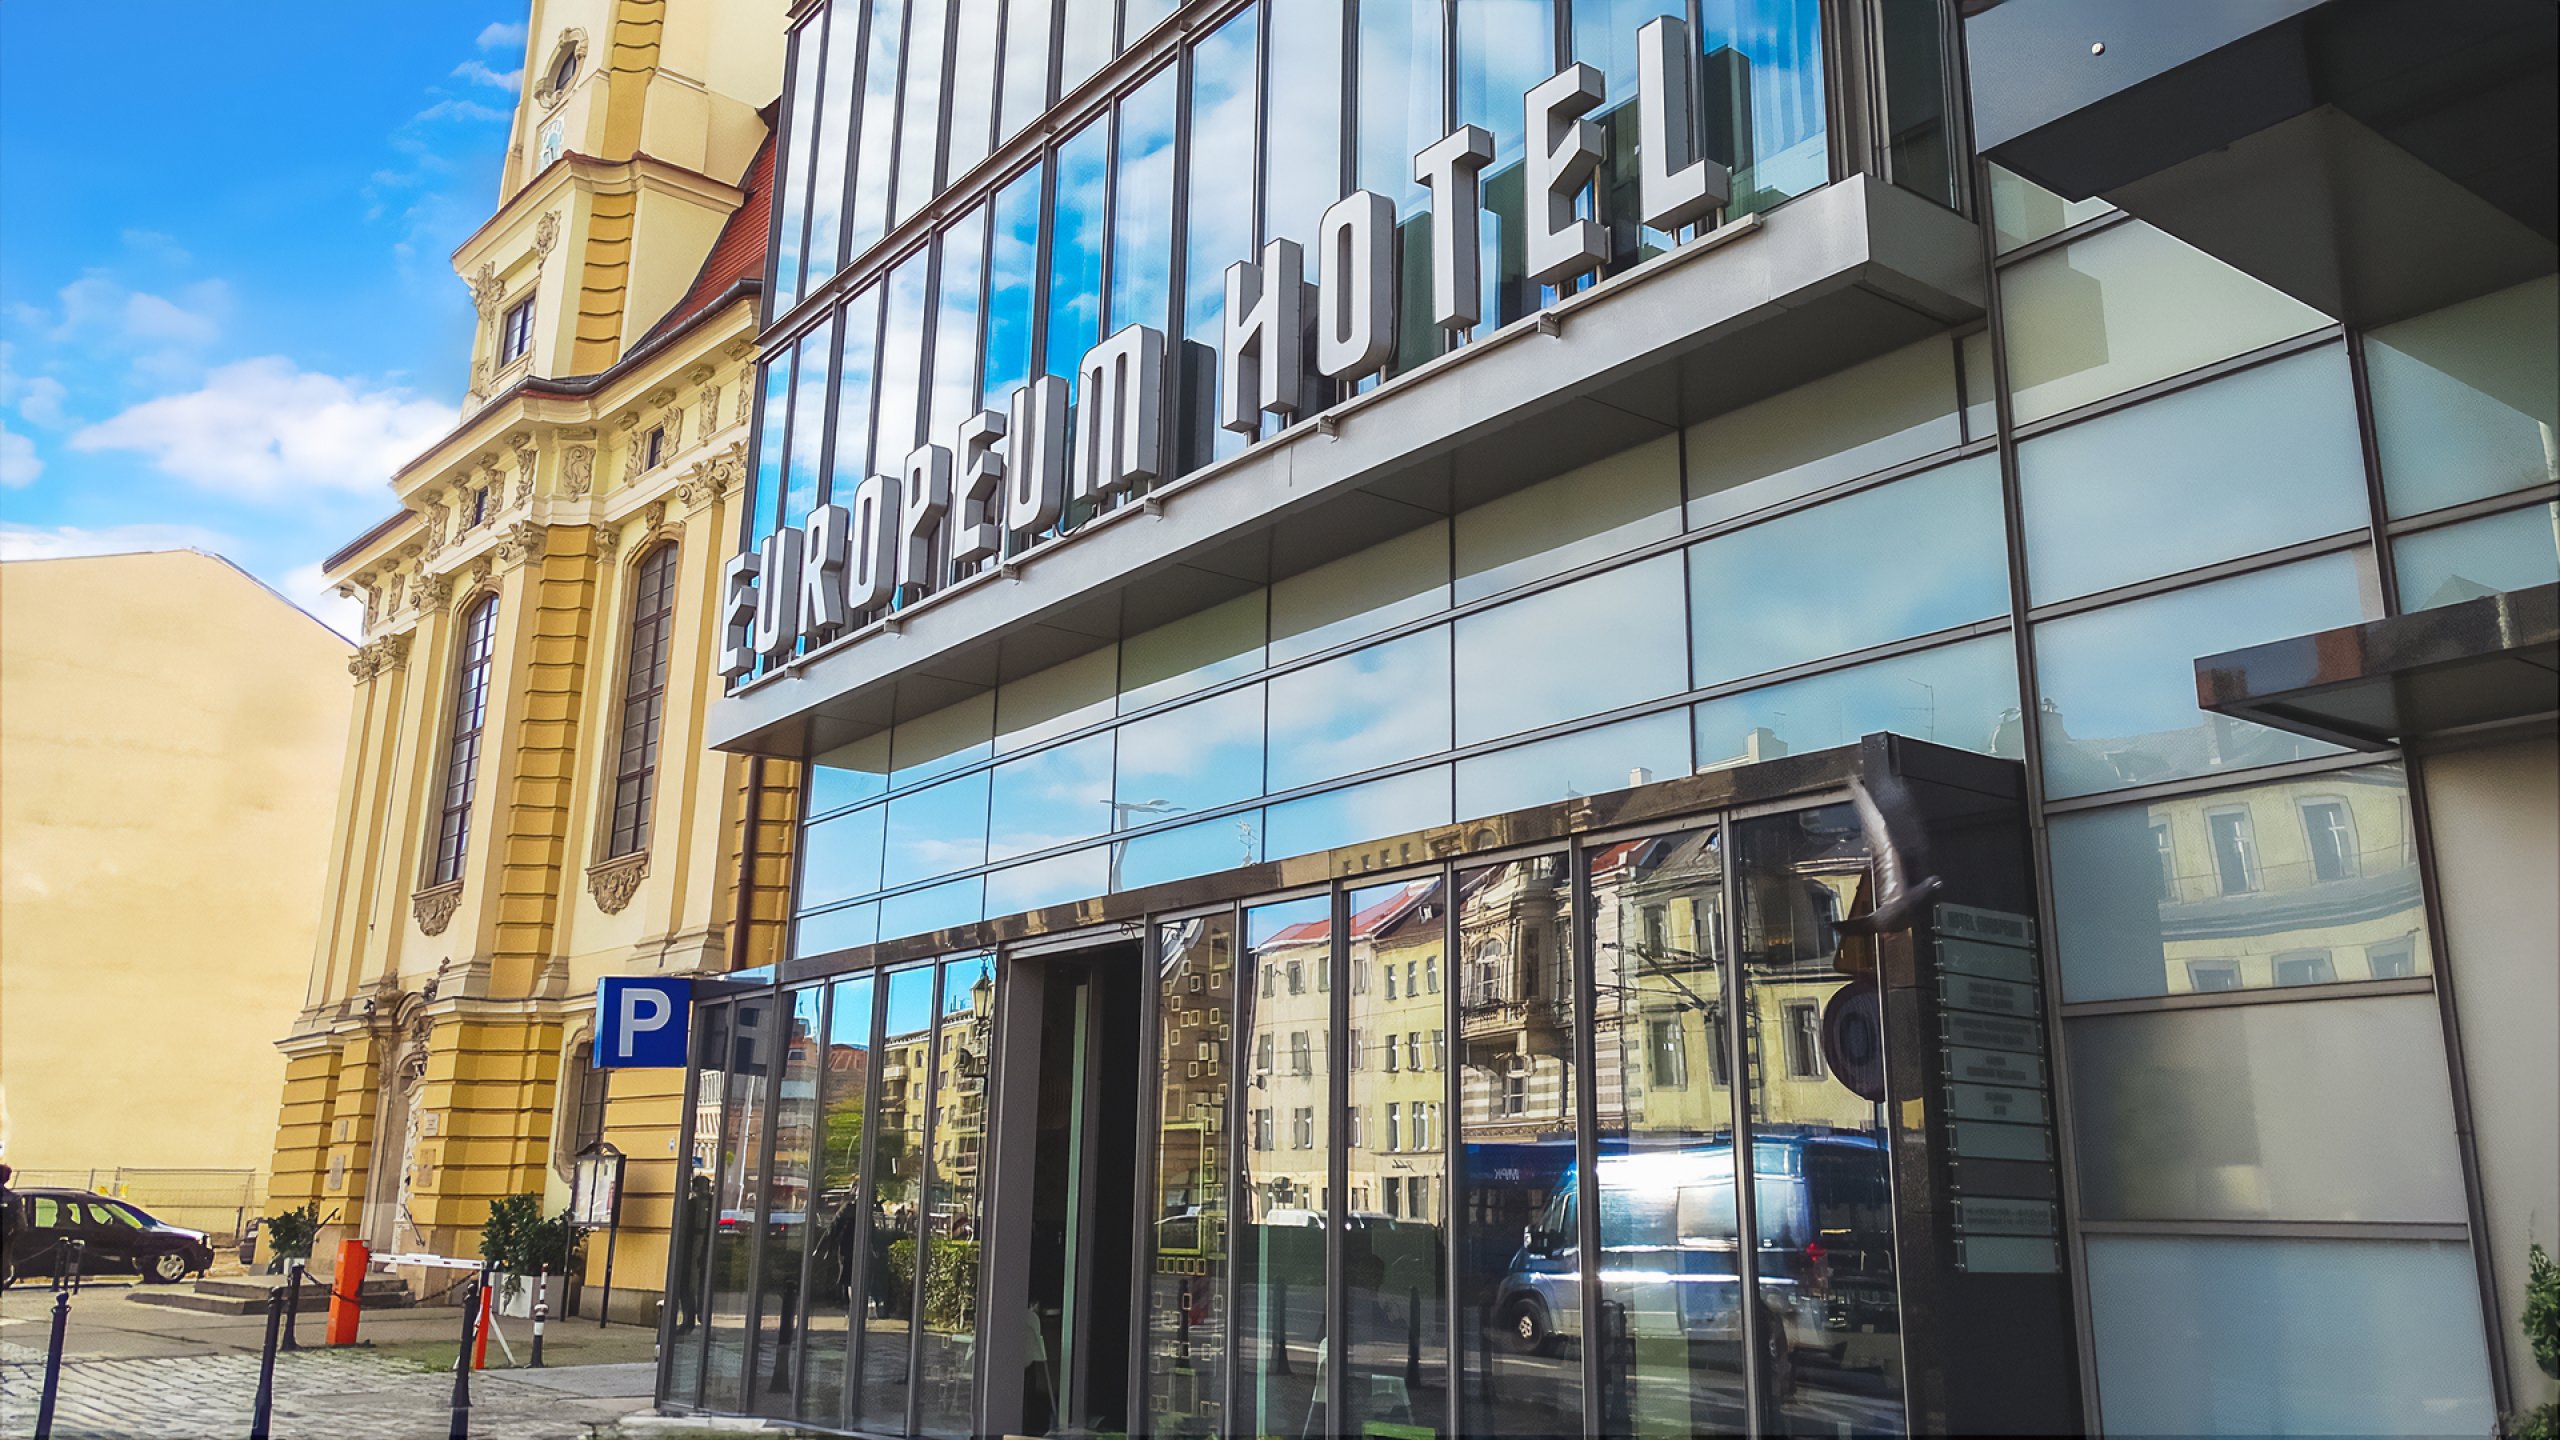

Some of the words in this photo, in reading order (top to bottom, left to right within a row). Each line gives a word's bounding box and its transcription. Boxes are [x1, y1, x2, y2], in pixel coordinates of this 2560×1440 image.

[718, 323, 1164, 677] EUROPEUM
[1222, 15, 1730, 432] HOTEL
[618, 987, 672, 1057] P
